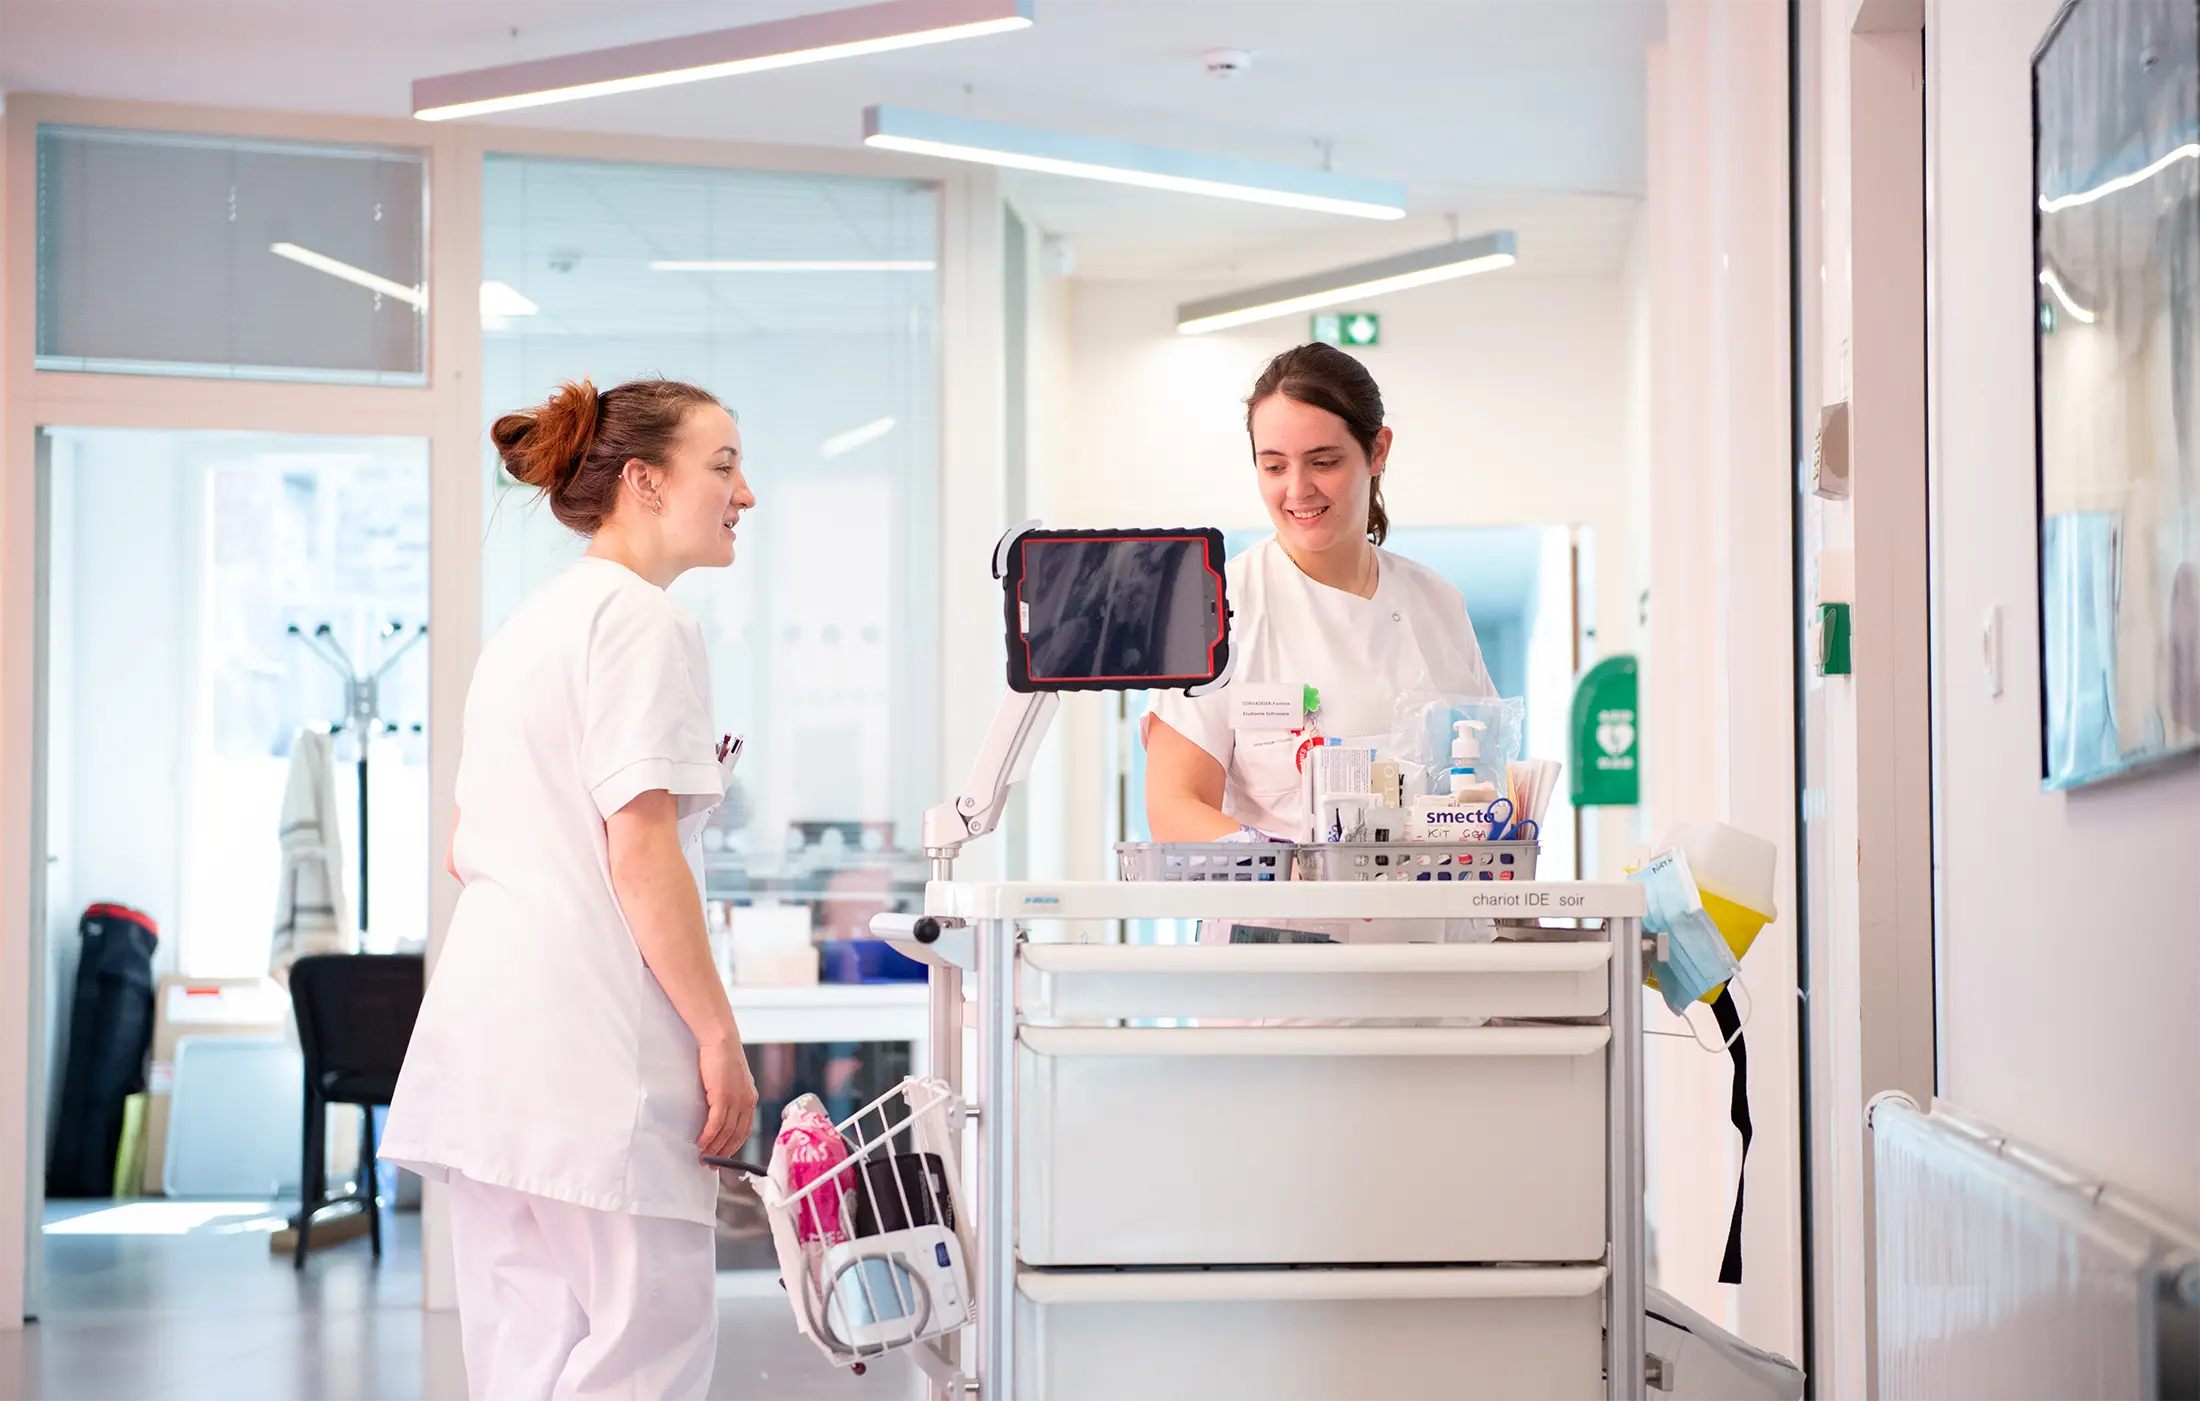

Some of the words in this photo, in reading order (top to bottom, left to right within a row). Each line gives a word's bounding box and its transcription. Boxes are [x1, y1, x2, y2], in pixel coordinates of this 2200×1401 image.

[1472, 893, 1519, 906] chariot
[1524, 893, 1550, 906] IDE
[1559, 893, 1584, 906] soir
